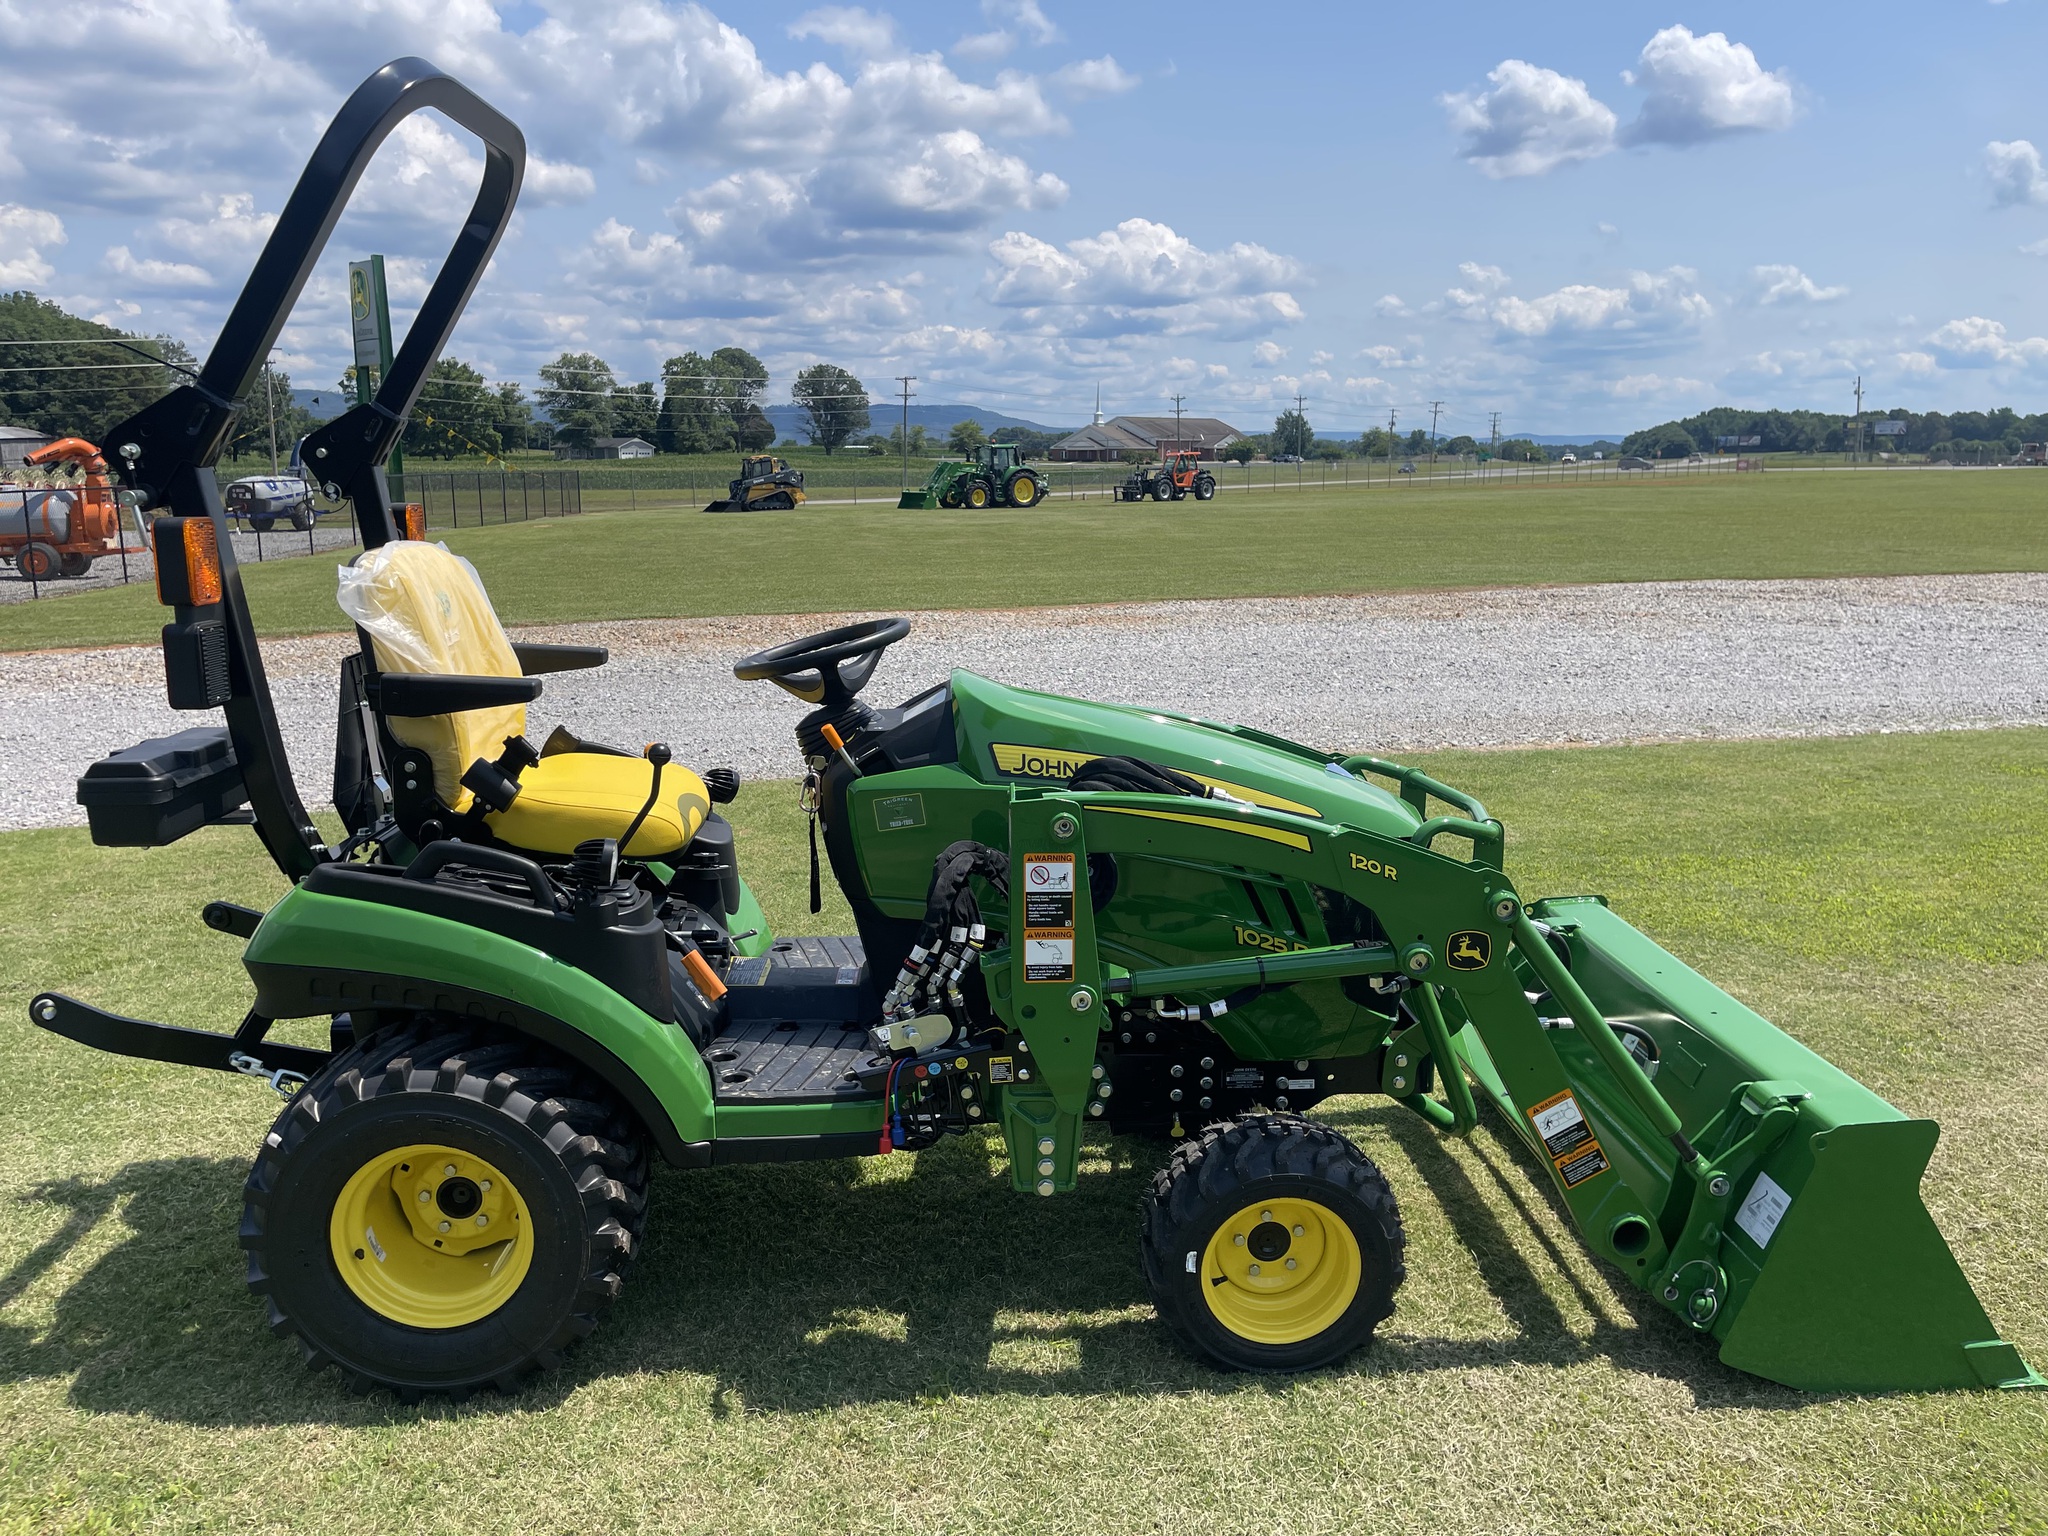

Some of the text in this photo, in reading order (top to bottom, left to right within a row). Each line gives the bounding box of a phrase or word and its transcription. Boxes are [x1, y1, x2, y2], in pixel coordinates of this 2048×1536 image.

[1013, 754, 1078, 776] JOHN
[1350, 852, 1397, 880] 120 R
[1234, 926, 1288, 952] 1025
[1539, 1093, 1567, 1110] WARNING
[1566, 1145, 1595, 1161] WARNING
